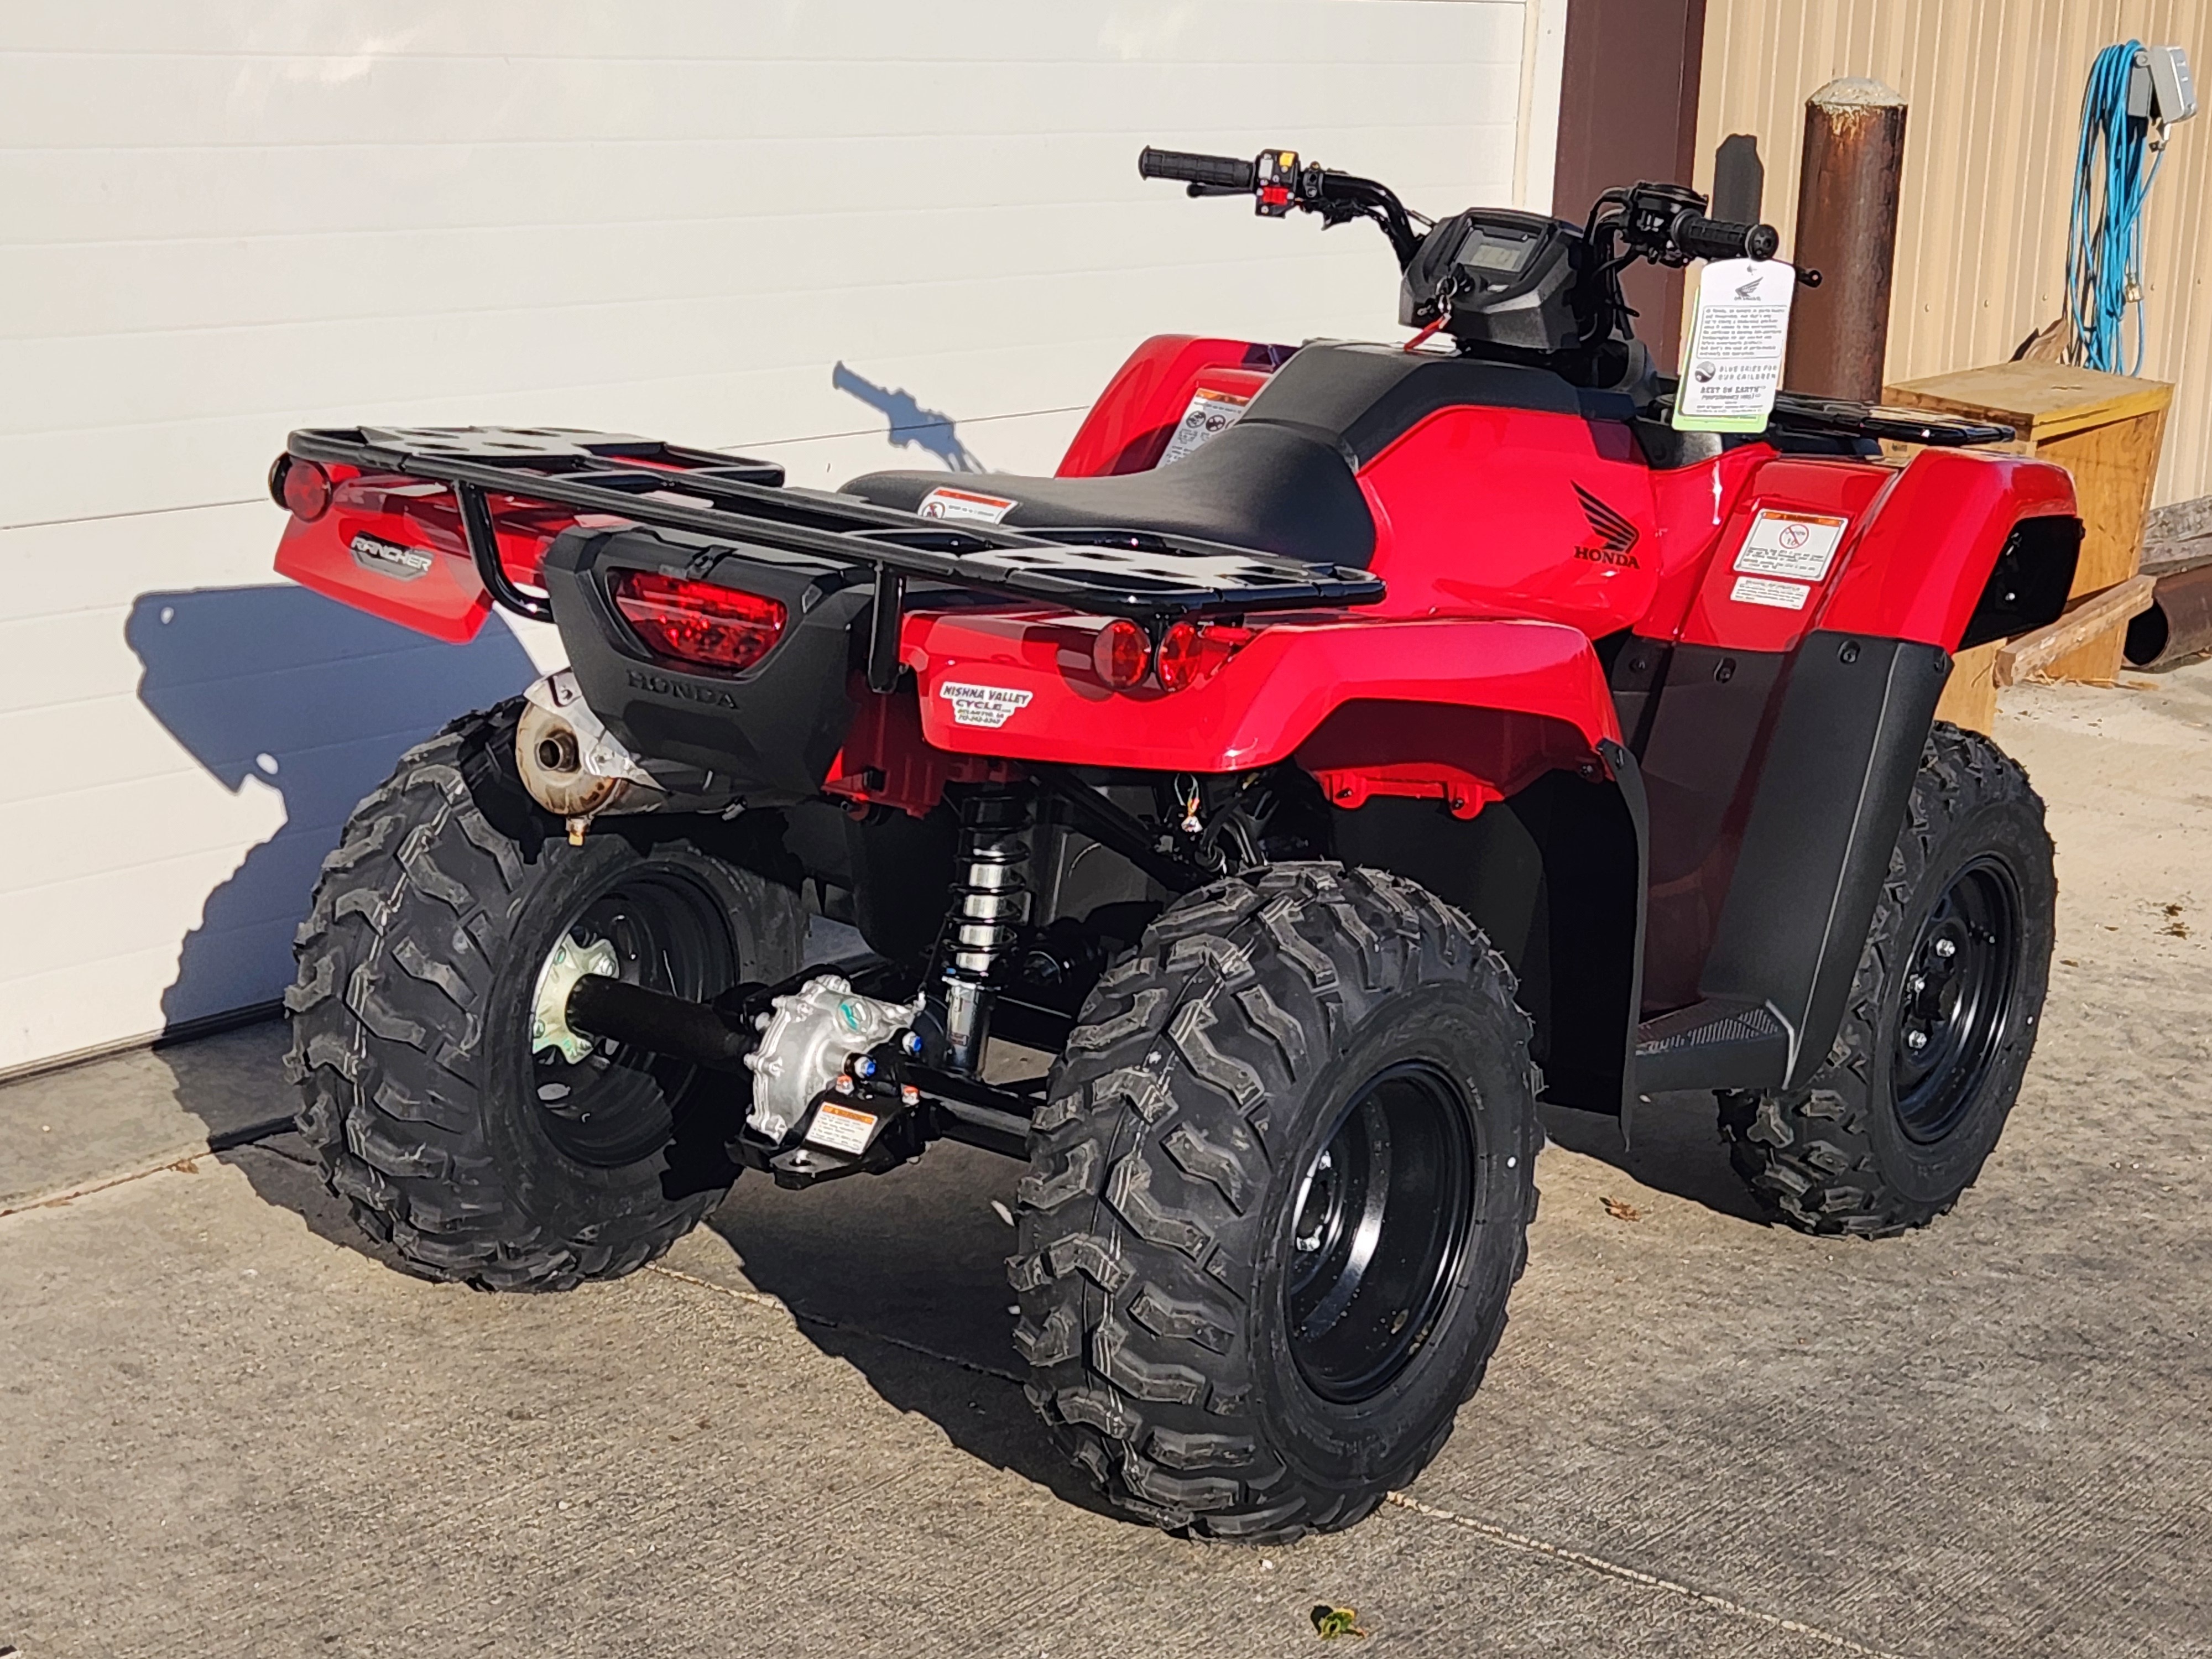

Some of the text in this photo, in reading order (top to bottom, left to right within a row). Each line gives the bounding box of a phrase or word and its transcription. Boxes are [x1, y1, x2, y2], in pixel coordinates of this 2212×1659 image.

[351, 536, 432, 572] RANCHER
[1574, 545, 1641, 570] HONDA
[626, 669, 740, 709] HONDA
[988, 690, 1030, 705] VALLEY
[956, 699, 1003, 711] CYCLE
